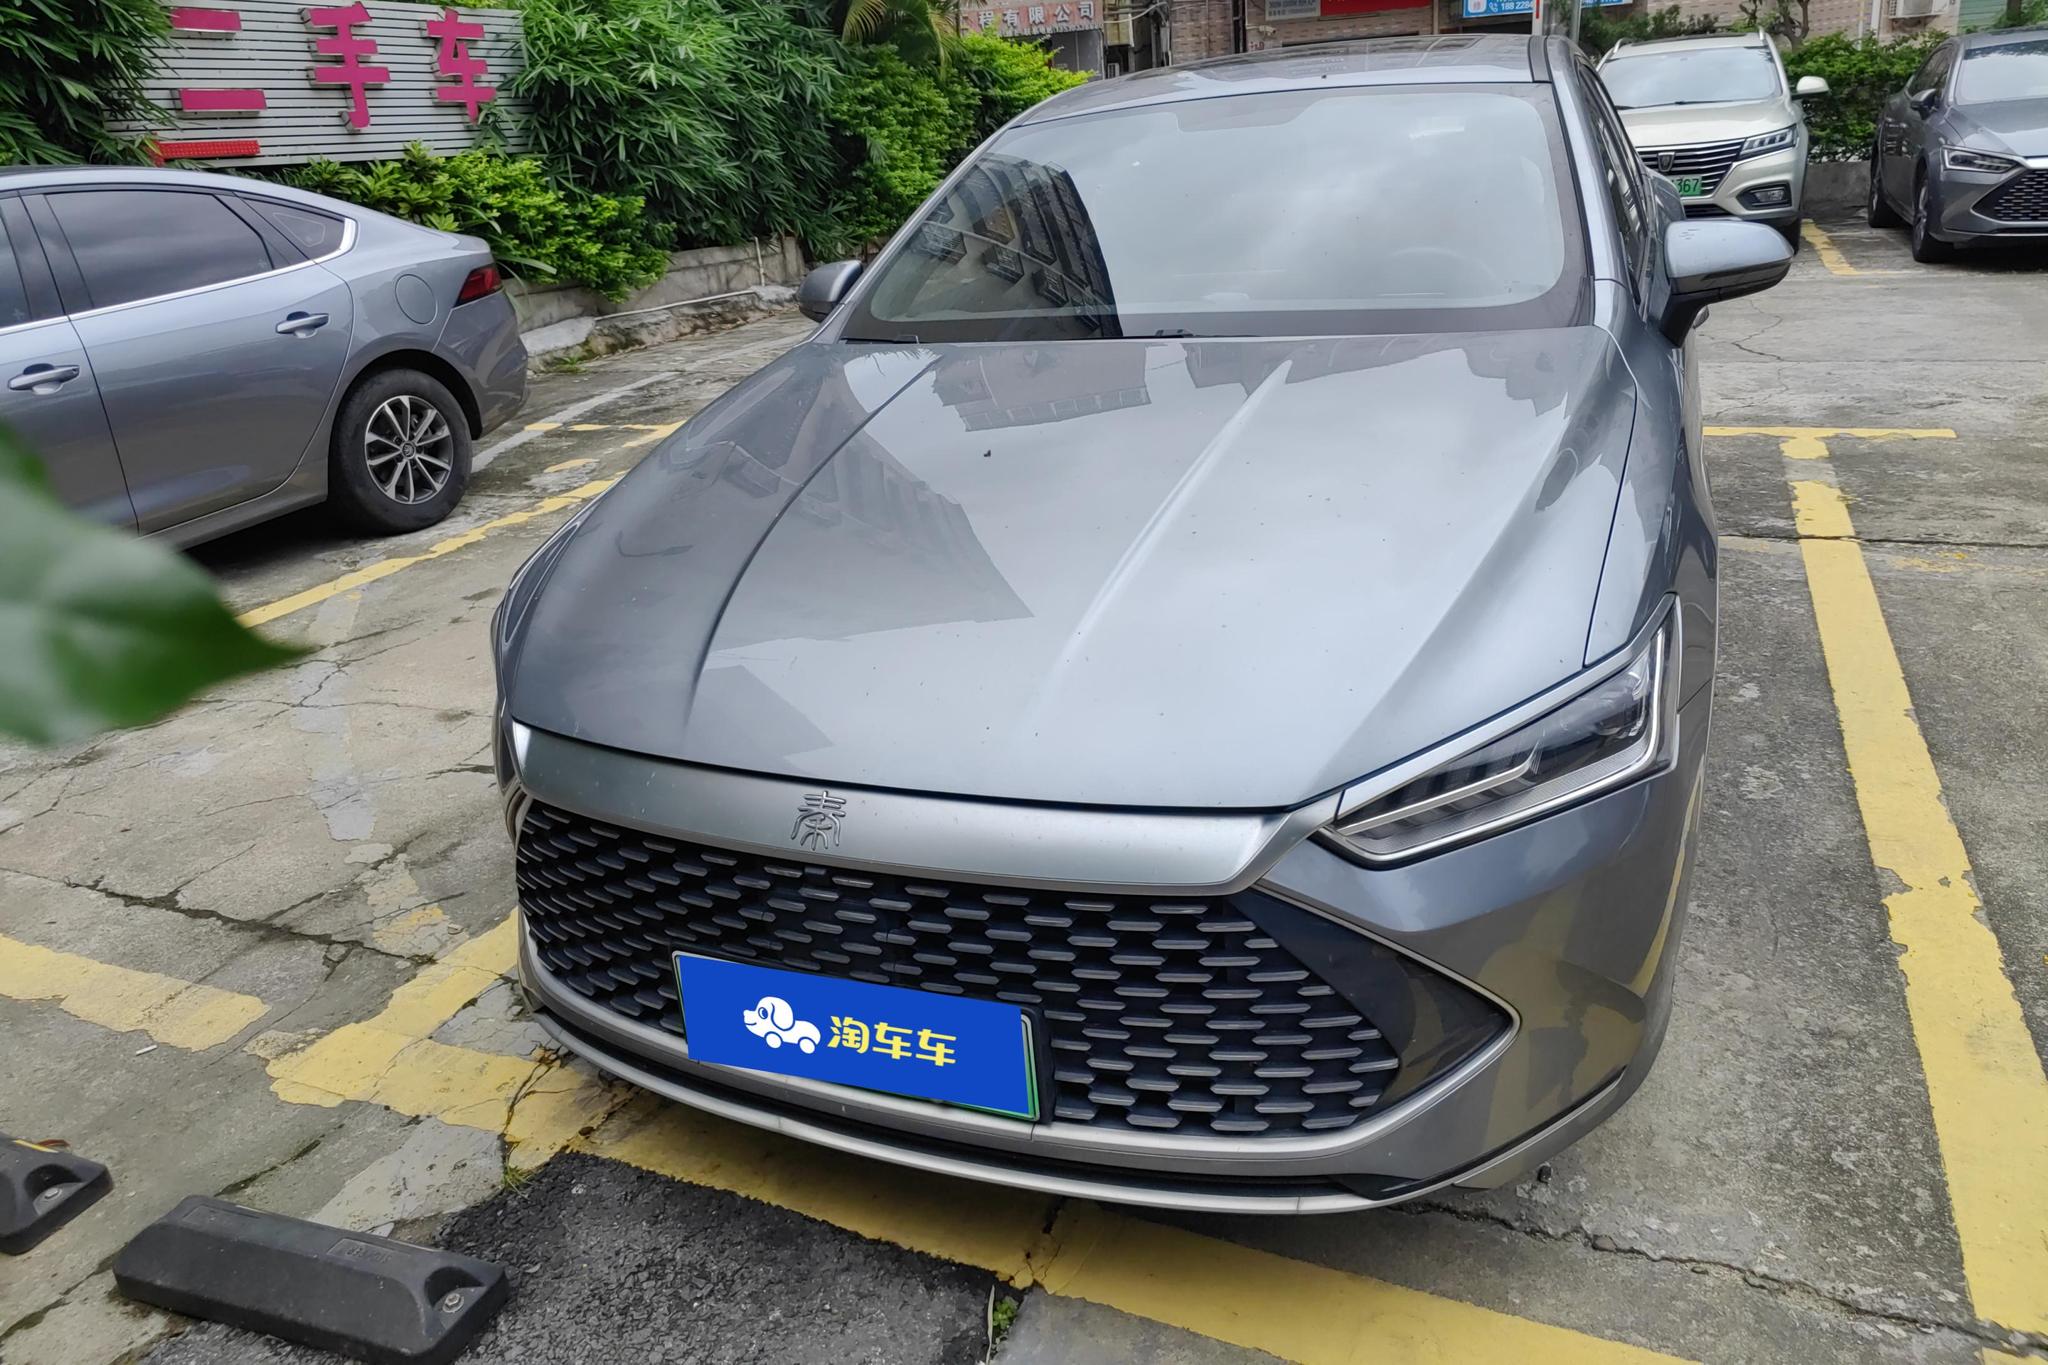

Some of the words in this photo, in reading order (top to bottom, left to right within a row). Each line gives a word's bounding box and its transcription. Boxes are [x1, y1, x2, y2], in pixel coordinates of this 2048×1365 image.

[170, 1, 497, 128] 二手车
[1671, 178, 1700, 193] 367
